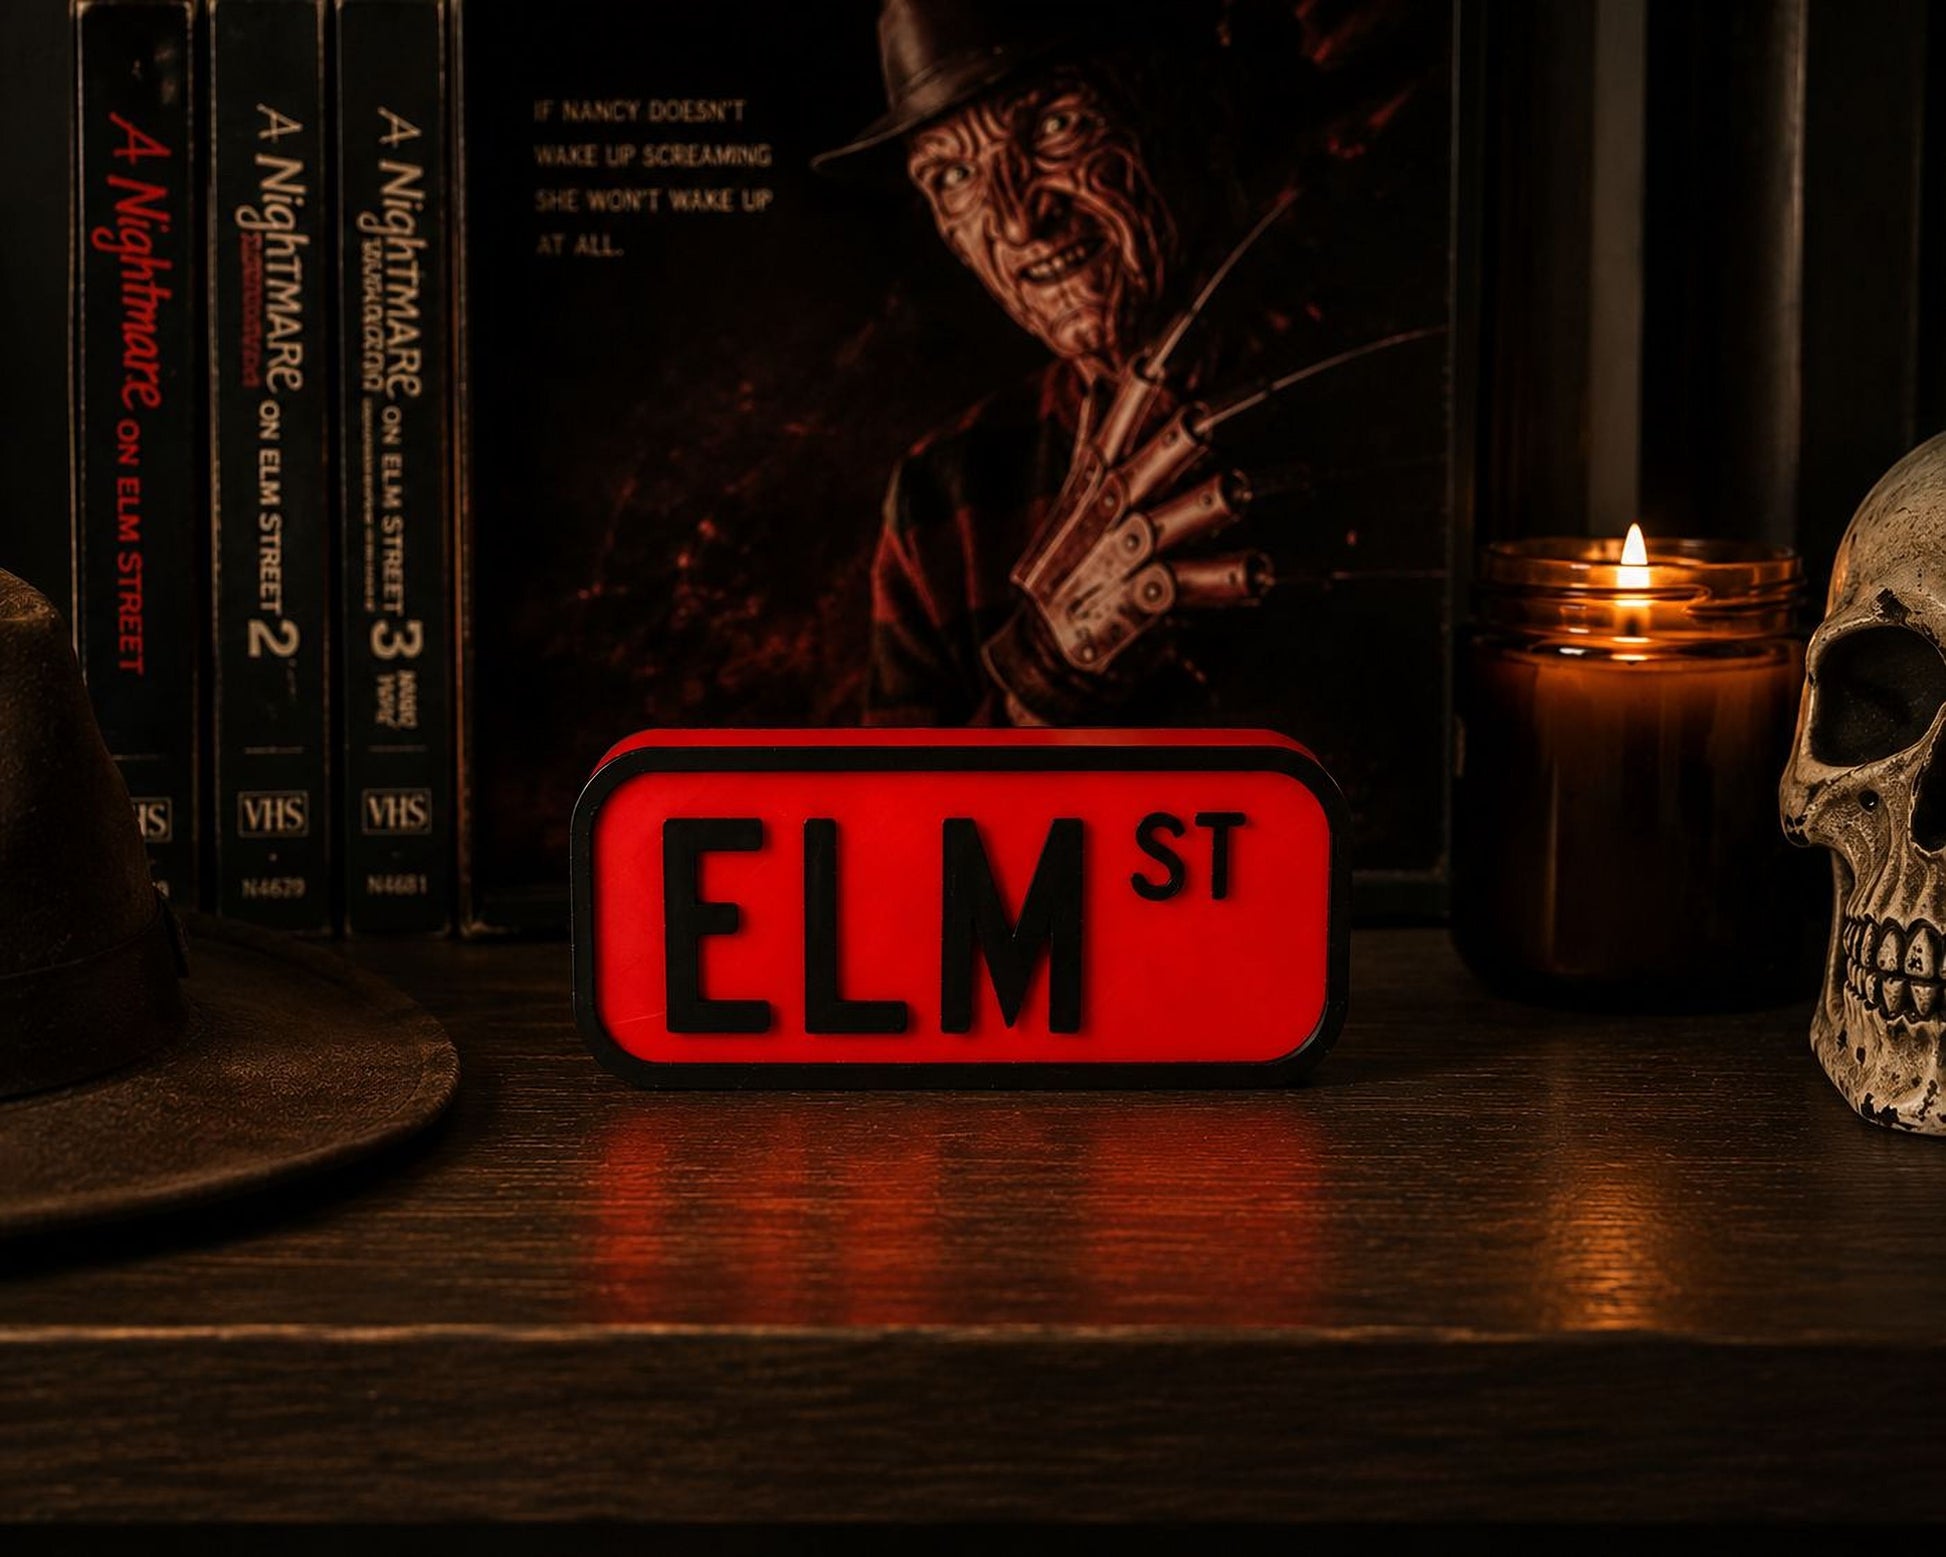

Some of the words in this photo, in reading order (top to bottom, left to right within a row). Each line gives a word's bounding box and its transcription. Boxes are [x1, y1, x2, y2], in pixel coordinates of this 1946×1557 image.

[255, 102, 304, 143] A
[376, 105, 423, 149] A
[533, 99, 554, 122] IF
[562, 99, 641, 122] NANCY
[649, 99, 746, 122] DOESN'T
[107, 111, 172, 166] A
[534, 143, 600, 167] WAKE
[605, 143, 638, 167] UP
[642, 143, 773, 168] SCREAMING
[534, 188, 580, 212] SHE
[585, 188, 662, 212] WON'T
[668, 188, 735, 212] WAKE
[740, 188, 775, 212] UP
[536, 232, 566, 257] AT
[573, 232, 625, 258] ALL.
[90, 173, 173, 410] Nightmare
[258, 399, 281, 441] ON
[380, 405, 402, 446] ON
[116, 419, 140, 466] ON
[258, 448, 282, 506] ELM
[380, 452, 403, 509] ELM
[117, 475, 141, 543] ELM
[259, 512, 283, 616] STREET
[381, 515, 404, 617] STREET
[117, 551, 145, 677] STREET
[247, 619, 300, 659] 2
[369, 619, 425, 661] 3
[242, 796, 306, 832] VHS
[367, 794, 428, 831] VHS
[662, 817, 1084, 1034] ELM
[1130, 811, 1247, 901] ST
